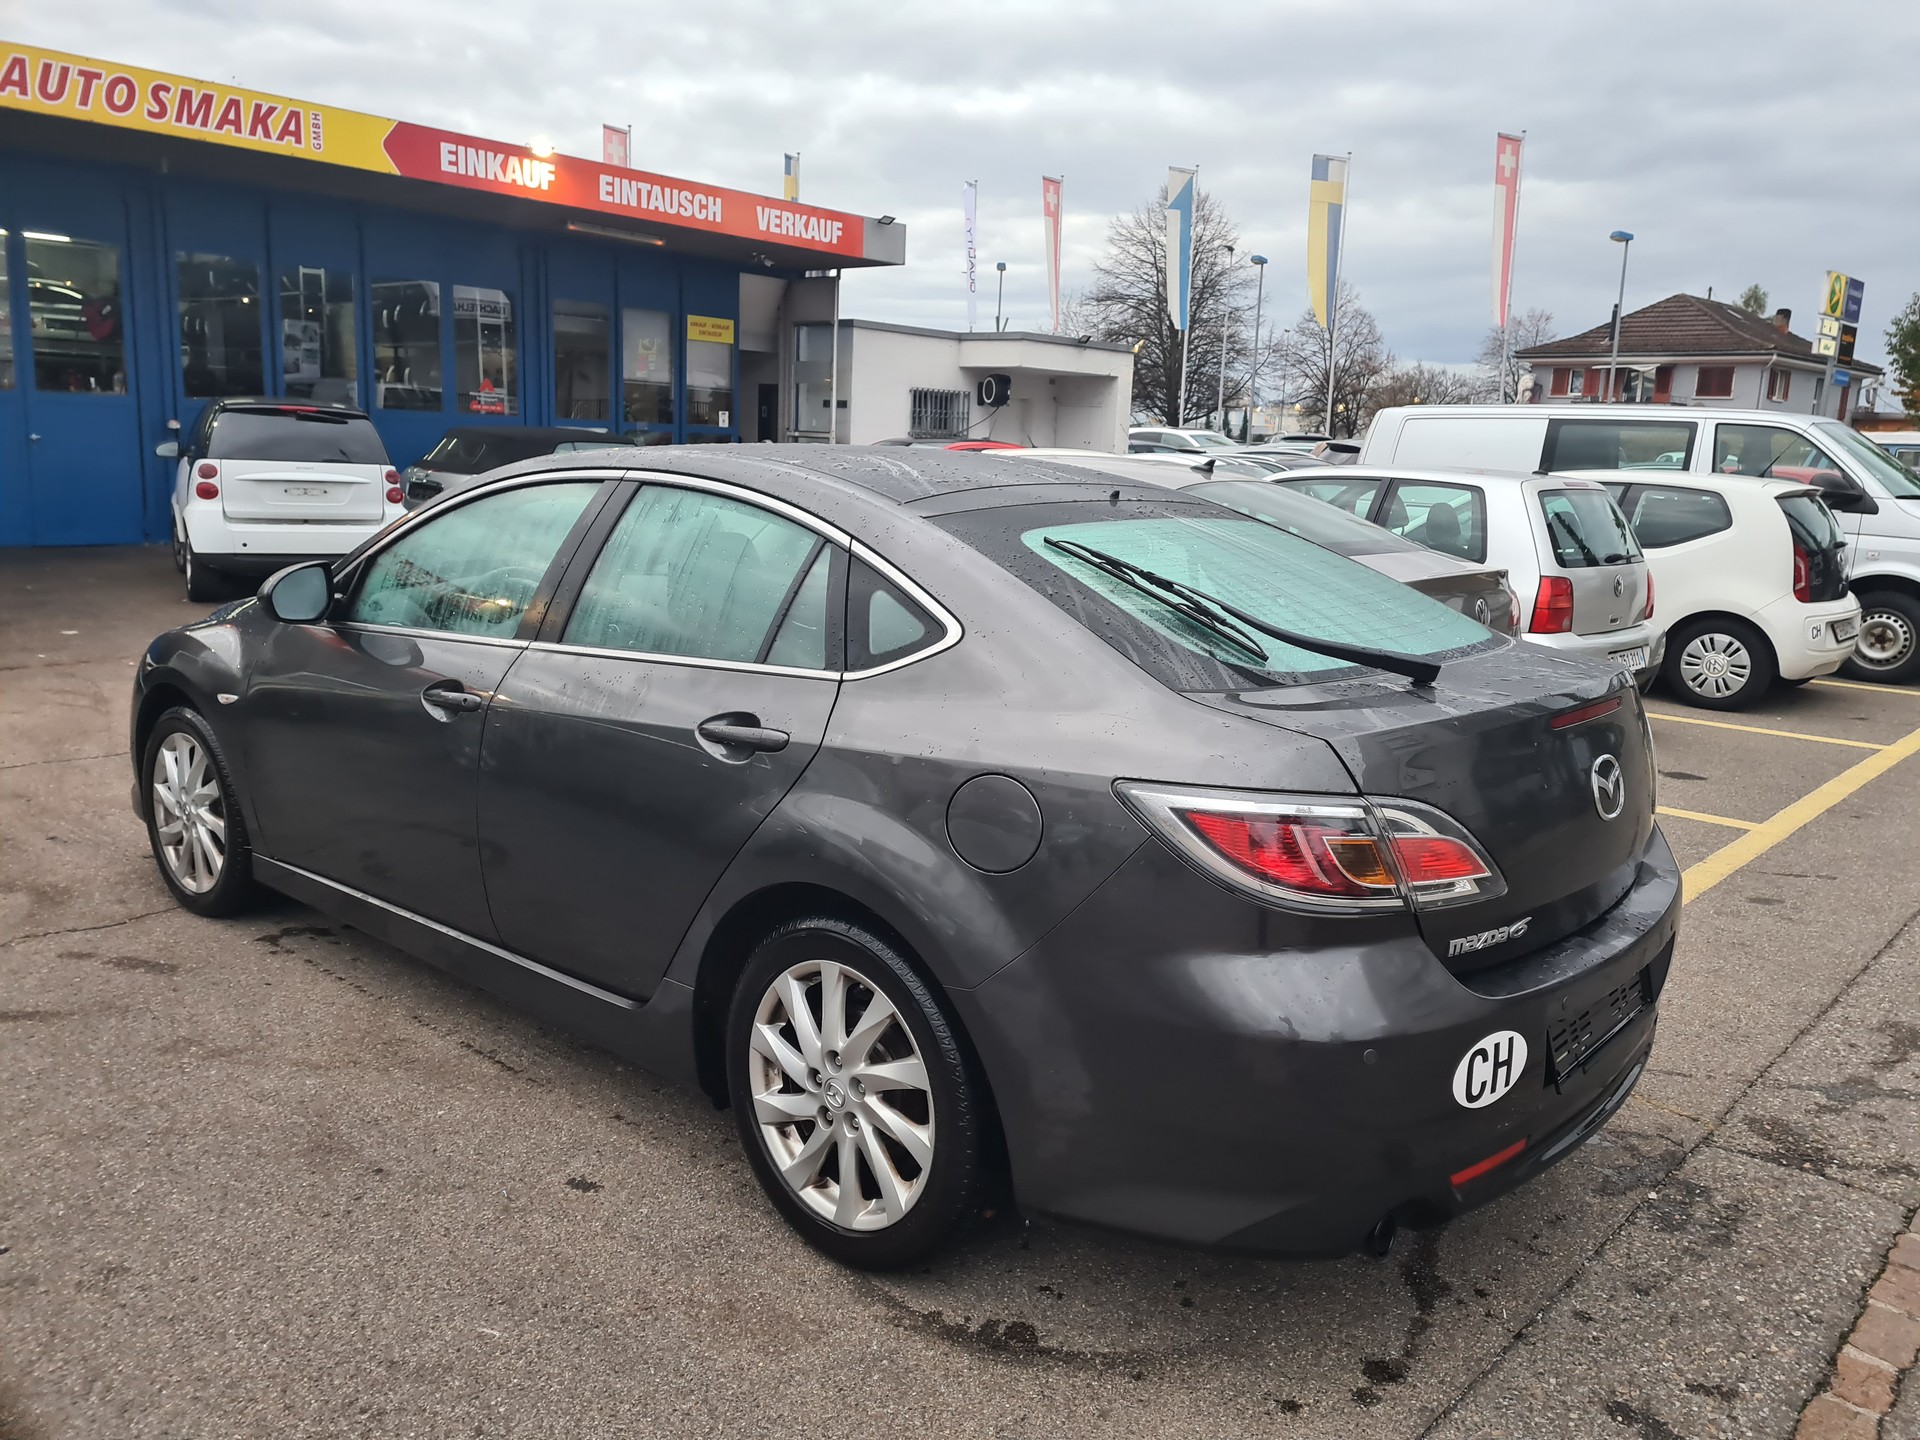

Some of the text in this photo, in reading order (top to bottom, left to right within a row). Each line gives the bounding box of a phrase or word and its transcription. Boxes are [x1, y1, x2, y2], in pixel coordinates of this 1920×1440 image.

[0, 55, 323, 151] AUTO SMAKA GMBH
[439, 141, 844, 245] EINKAUF EINTAUSCH VERKAUF
[1811, 623, 1821, 640] CH
[1465, 1035, 1515, 1104] CH
